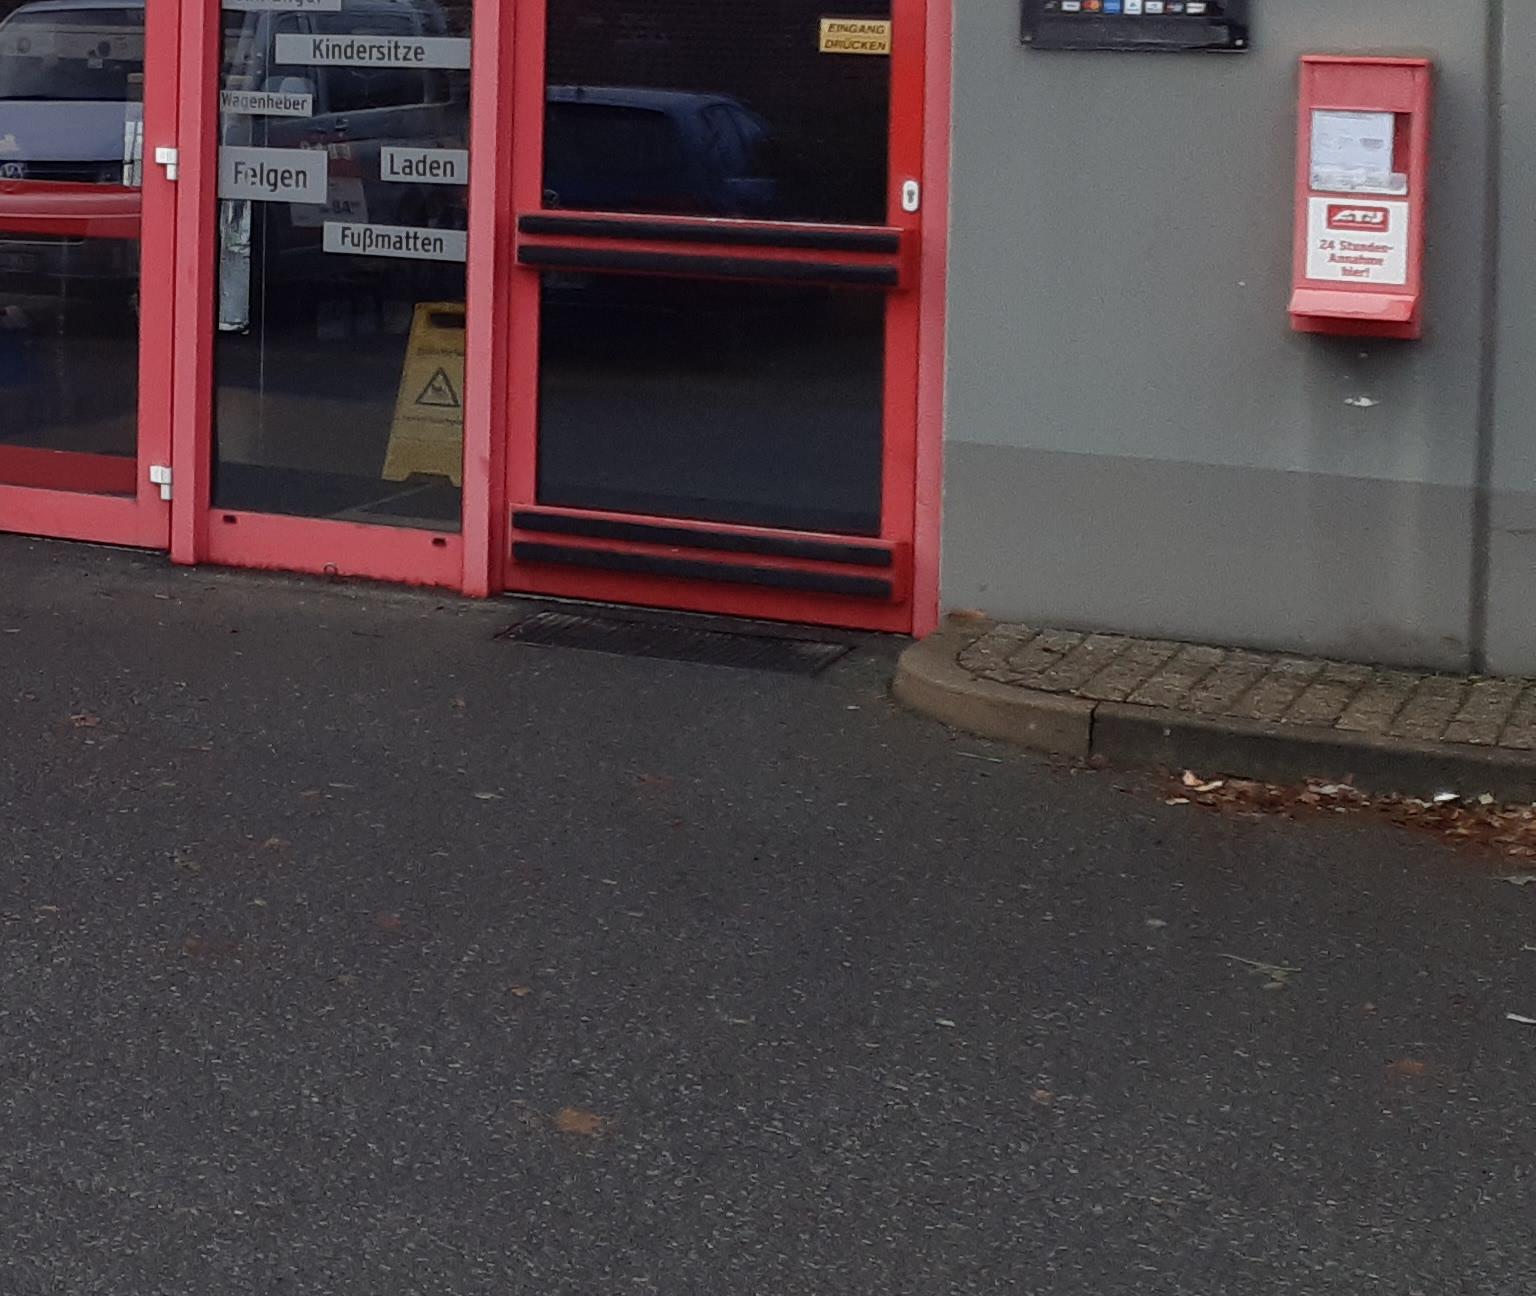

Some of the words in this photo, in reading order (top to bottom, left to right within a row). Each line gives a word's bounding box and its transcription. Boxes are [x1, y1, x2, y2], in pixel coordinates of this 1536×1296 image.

[828, 23, 885, 35] EINGANG
[312, 39, 425, 62] Kindersitze
[824, 39, 886, 51] DRÜCKEN
[222, 92, 307, 112] Wagenheber
[389, 154, 455, 178] Laden
[234, 161, 307, 193] Felgen
[341, 226, 444, 253] Fußmatten
[1319, 239, 1335, 250] 24
